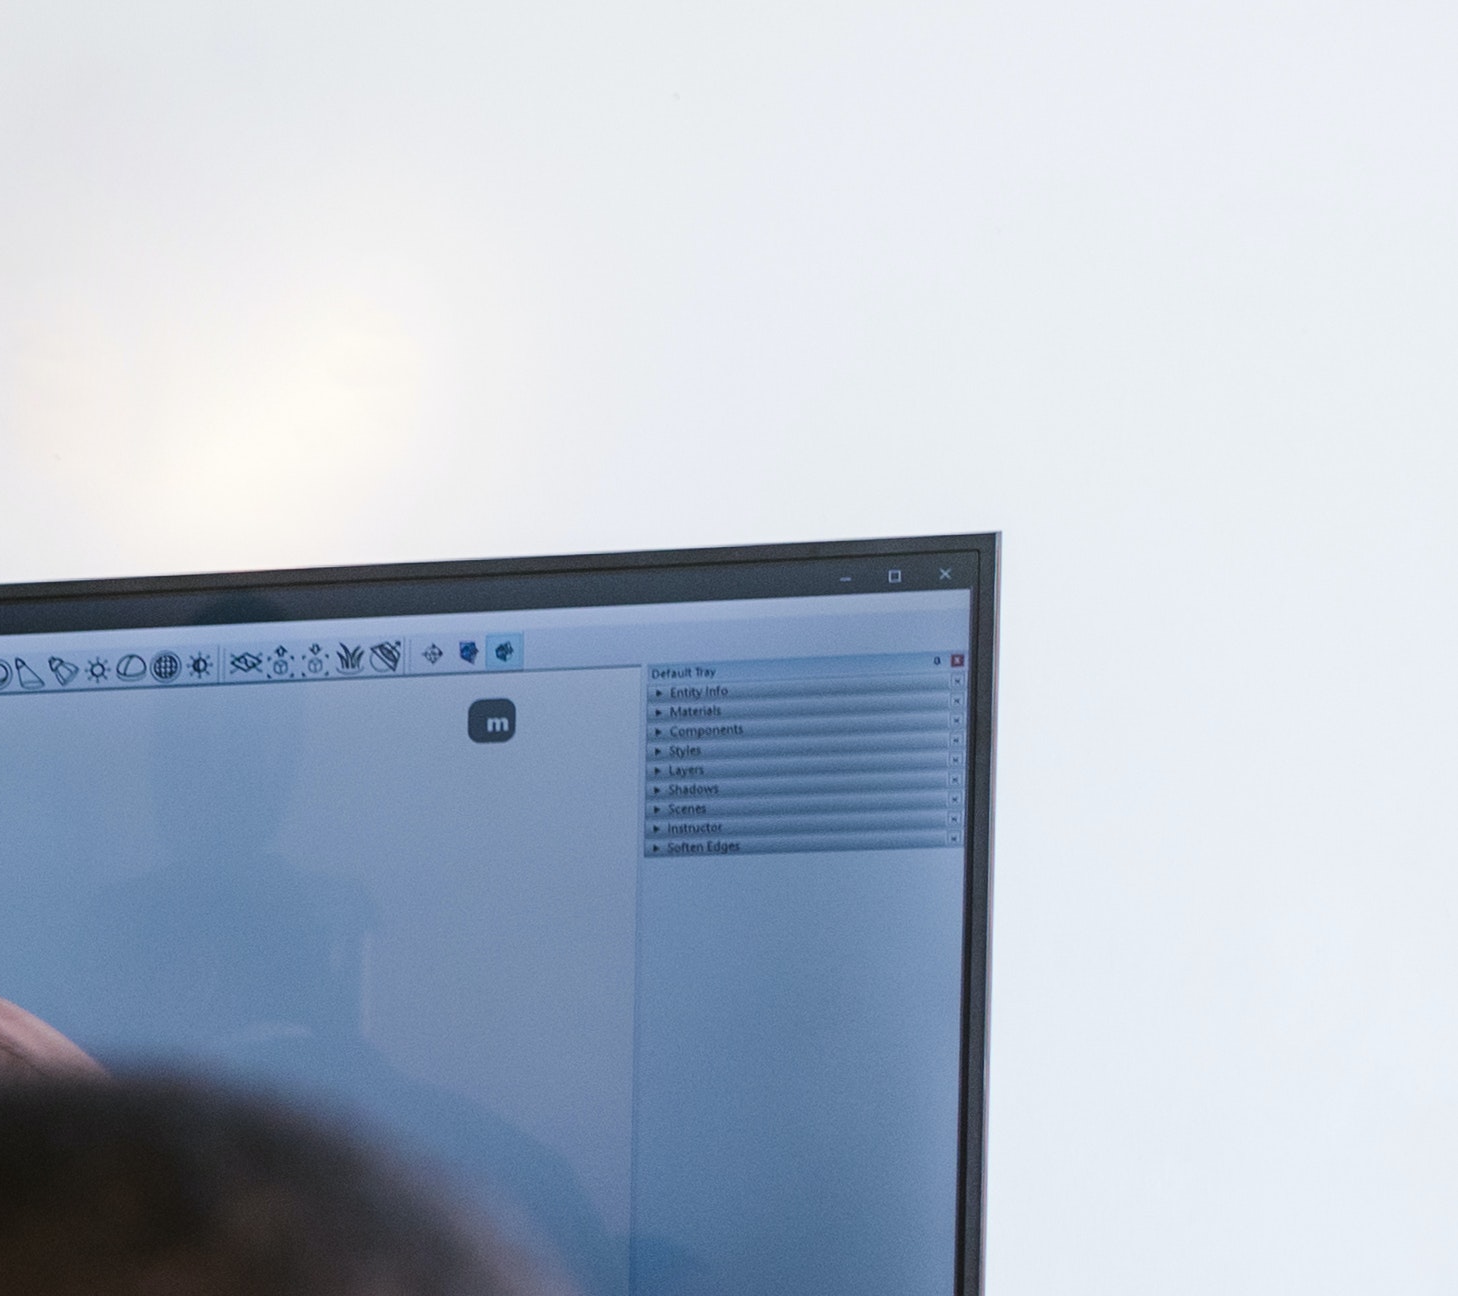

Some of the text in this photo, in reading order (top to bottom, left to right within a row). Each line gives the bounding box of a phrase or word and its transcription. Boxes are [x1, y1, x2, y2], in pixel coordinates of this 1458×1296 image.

[651, 666, 716, 680] Default Tray
[670, 685, 728, 700] Entity Info
[669, 705, 722, 718] Materials
[487, 717, 509, 732] m
[669, 724, 744, 739] Components
[669, 744, 701, 758] Styles
[669, 764, 704, 778] Layers
[669, 783, 719, 796] Shadows
[668, 803, 707, 815] Scenes
[668, 822, 722, 834] Instructor
[668, 841, 740, 855] Soften Edges
